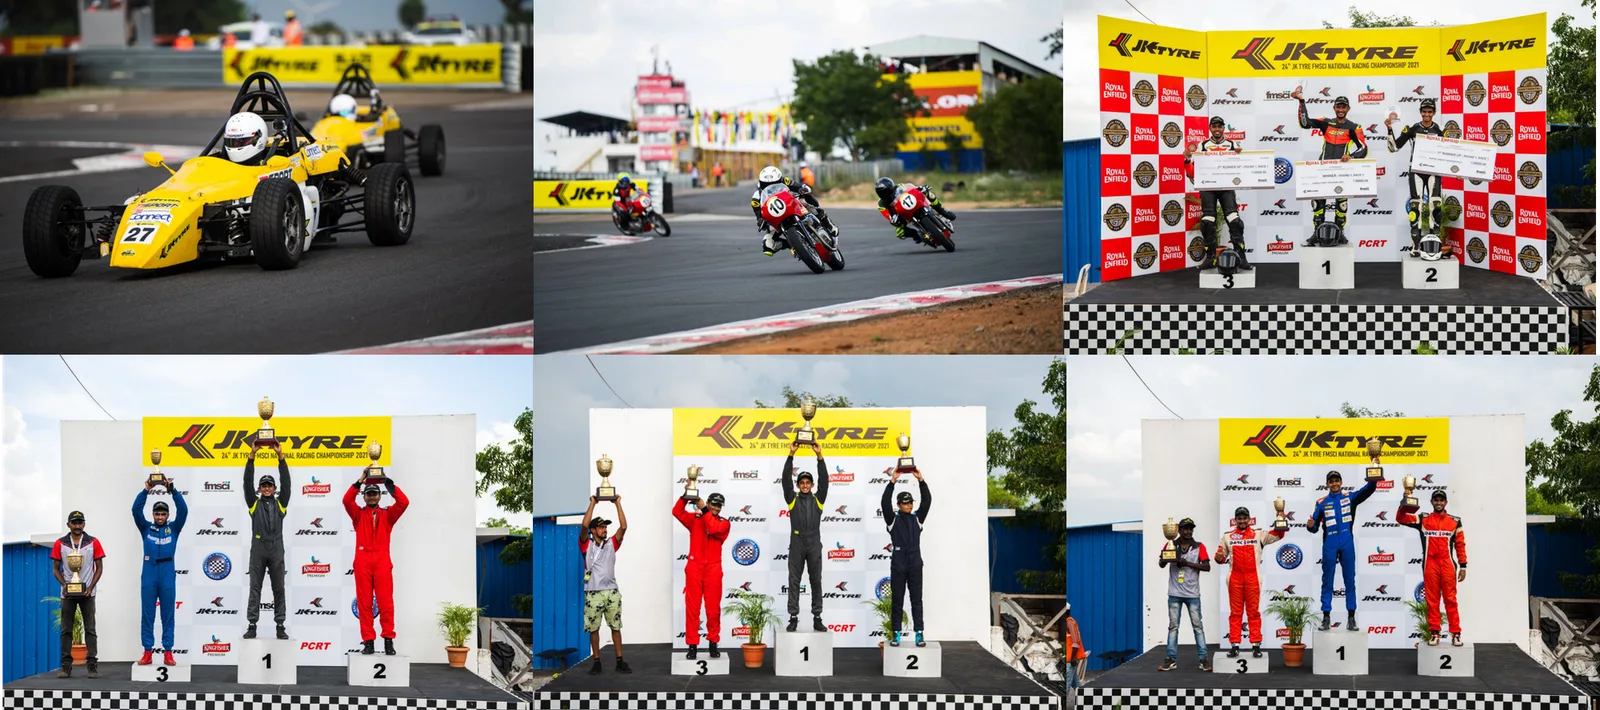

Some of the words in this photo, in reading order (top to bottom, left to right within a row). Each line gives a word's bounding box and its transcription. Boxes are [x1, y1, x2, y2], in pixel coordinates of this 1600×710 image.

[1132, 40, 1201, 60] JKTYRE
[1274, 42, 1419, 60] JKTYRE
[1464, 38, 1536, 54] JKTYRE
[1105, 82, 1124, 91] ROYAL
[1162, 88, 1179, 96] ROYAL
[1104, 90, 1127, 100] ENFIELD
[1161, 95, 1182, 104] ENFIELD
[1491, 92, 1512, 100] ENFIELD
[1134, 134, 1156, 142] ENFIELD
[1518, 133, 1541, 142] ENFIELD
[1106, 168, 1124, 176] ROYAL
[570, 188, 613, 200] JKTY
[770, 198, 786, 214] 10
[902, 195, 914, 208] 17
[1134, 215, 1156, 223] ENFIELD
[1466, 211, 1486, 219] ENFIELD
[1520, 209, 1538, 217] ROYAL
[1518, 217, 1541, 226] ENFIELD
[124, 227, 156, 242] 27
[1162, 252, 1183, 260] ENFIELD
[1493, 246, 1510, 255] ROYAL
[1105, 259, 1128, 268] ENFIELD
[1492, 254, 1513, 263] ENFIELD
[1322, 261, 1330, 275] 1
[1425, 268, 1438, 282] 2
[1222, 275, 1234, 289] 3
[742, 422, 888, 440] JKYRE
[733, 470, 758, 478] fmsci
[204, 482, 231, 490] fmsci
[300, 642, 331, 650] PCRT
[800, 646, 809, 661] 1
[1336, 646, 1344, 660] 1
[262, 654, 271, 668] 1
[906, 655, 918, 670] 2
[1236, 659, 1248, 674] 3
[1440, 654, 1452, 669] 2
[373, 663, 386, 679] 2
[696, 660, 708, 675] 3
[156, 666, 168, 682] 3
